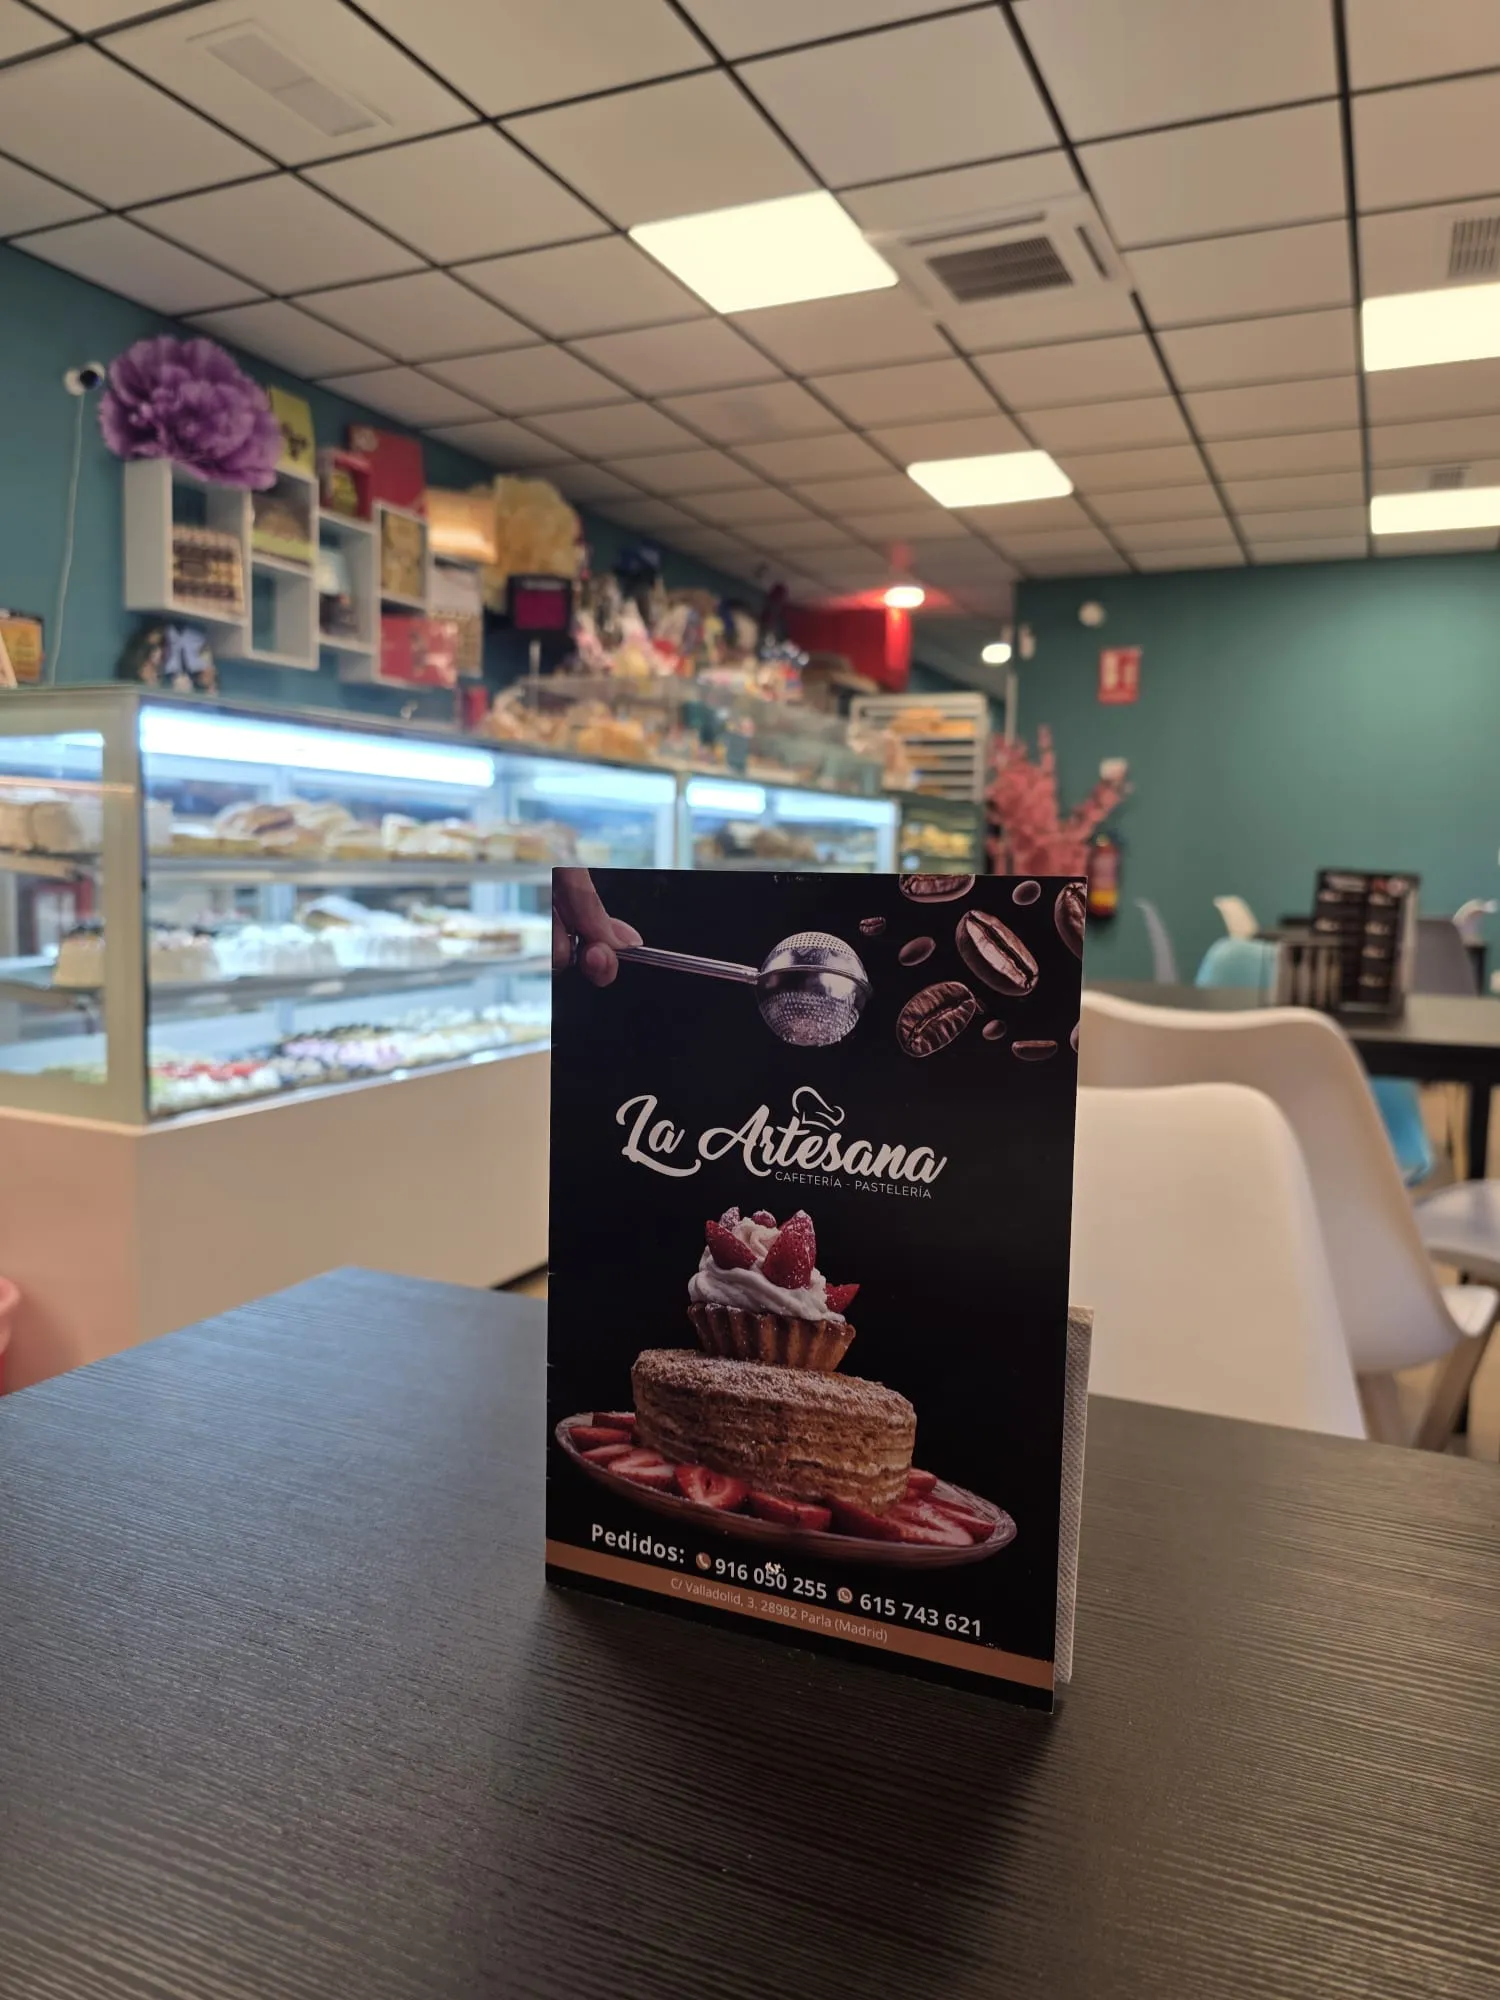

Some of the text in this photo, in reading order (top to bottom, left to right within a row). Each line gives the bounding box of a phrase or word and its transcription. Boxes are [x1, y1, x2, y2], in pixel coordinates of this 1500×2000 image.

[615, 1094, 948, 1184] La Artesana
[775, 1171, 843, 1189] CAFETERÍA
[854, 1180, 932, 1200] PASTELERÍA
[591, 1523, 982, 1638] Pedidos: 916 050 255 615 743 621
[670, 1577, 684, 1591] C/
[685, 1581, 743, 1607] Valladolid,
[760, 1600, 798, 1620] 28982
[801, 1610, 832, 1628] Parla
[834, 1617, 888, 1643] (Madrid)
